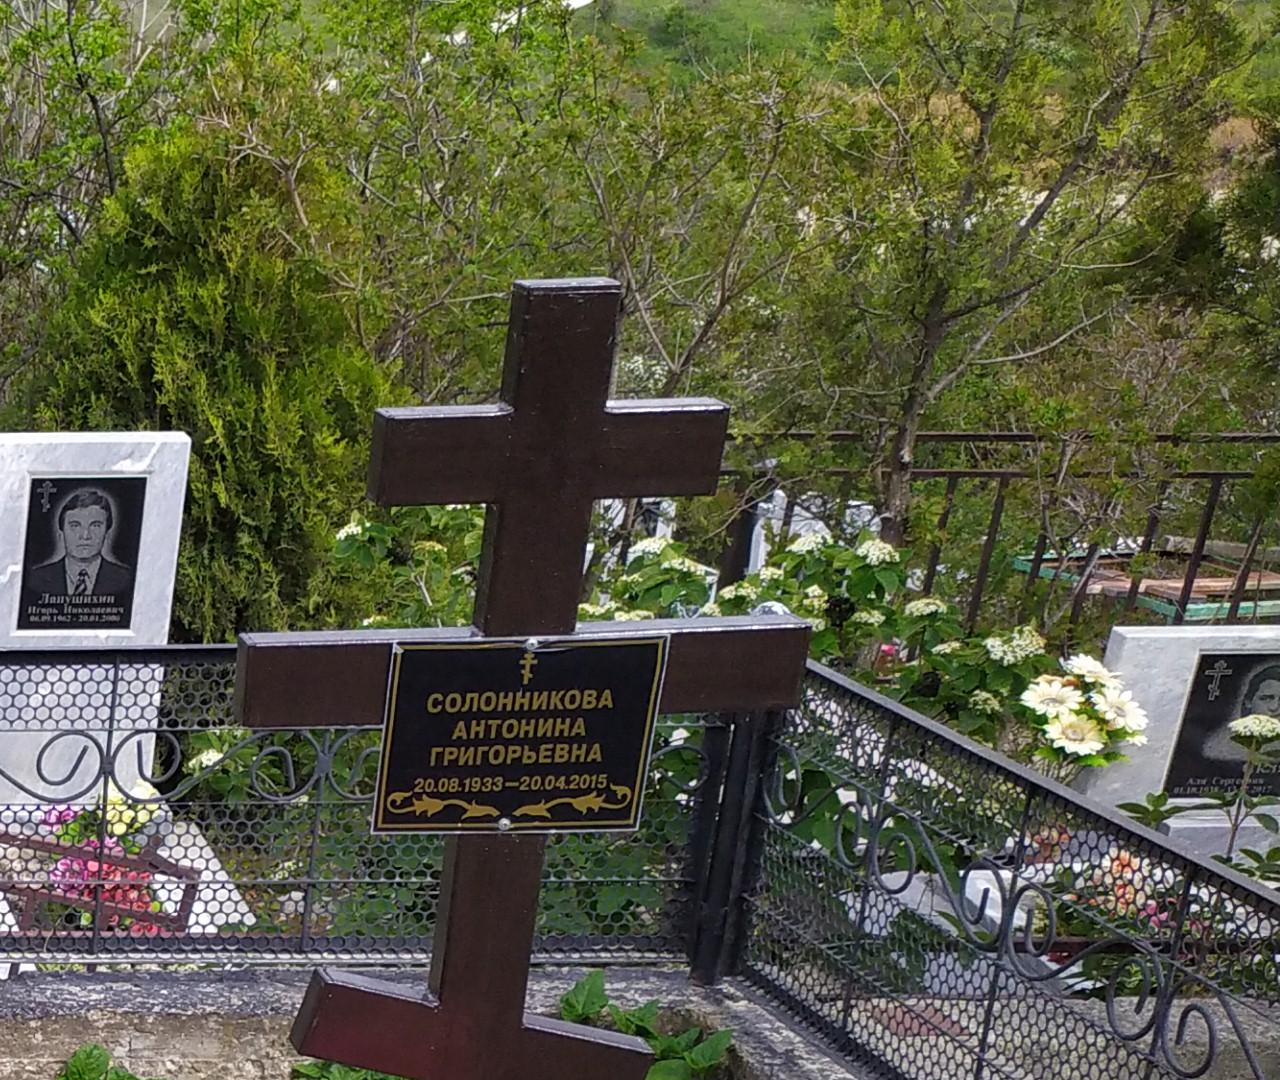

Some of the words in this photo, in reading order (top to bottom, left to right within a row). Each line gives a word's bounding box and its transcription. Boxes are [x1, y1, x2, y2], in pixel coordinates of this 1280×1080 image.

[426, 688, 614, 714] СОЛОННИКОВА
[451, 716, 587, 741] АНТОНИНА
[429, 742, 603, 767] ГРИГОРЬЕВНА
